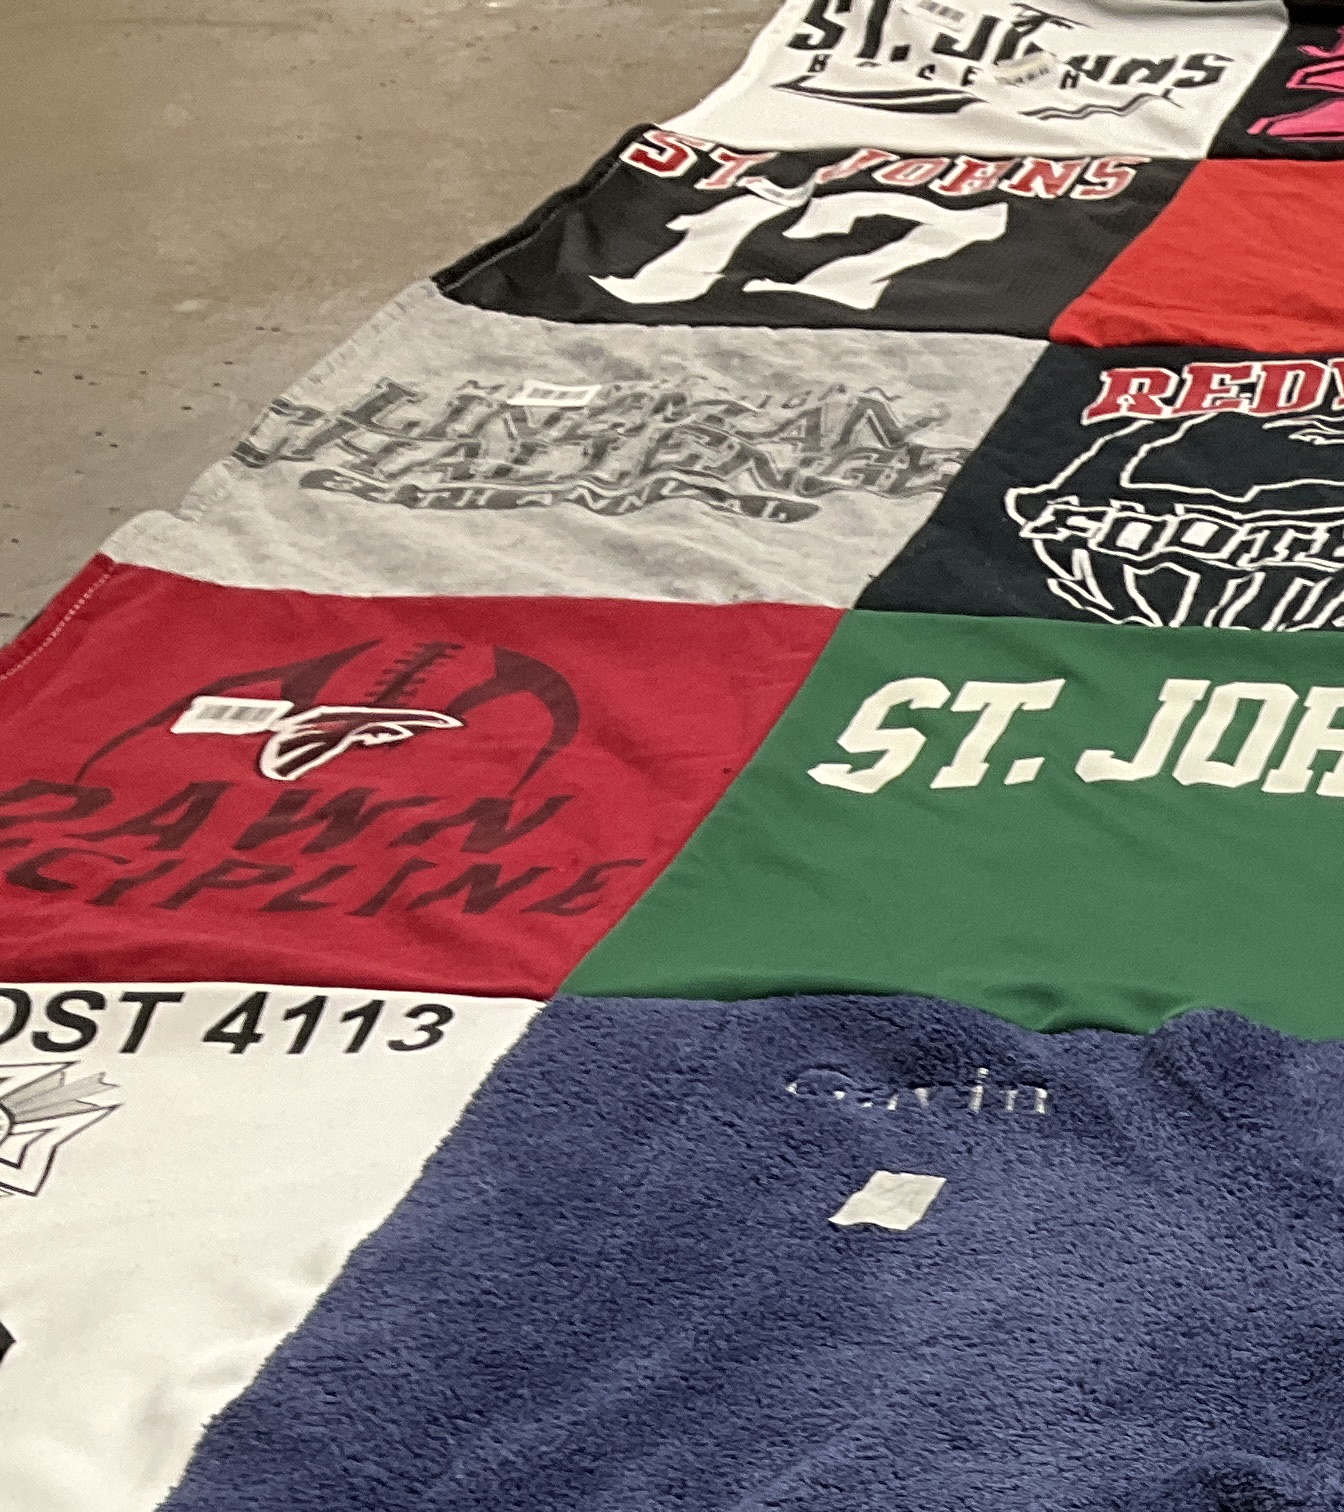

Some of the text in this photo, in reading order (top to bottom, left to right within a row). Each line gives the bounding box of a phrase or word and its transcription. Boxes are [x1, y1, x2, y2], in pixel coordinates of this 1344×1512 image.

[620, 128, 1152, 199] ST. JOHNS
[588, 189, 1009, 310] 17
[808, 677, 1066, 793] ST.
[0, 838, 648, 918] CIPLINE
[203, 991, 455, 1055] 4113
